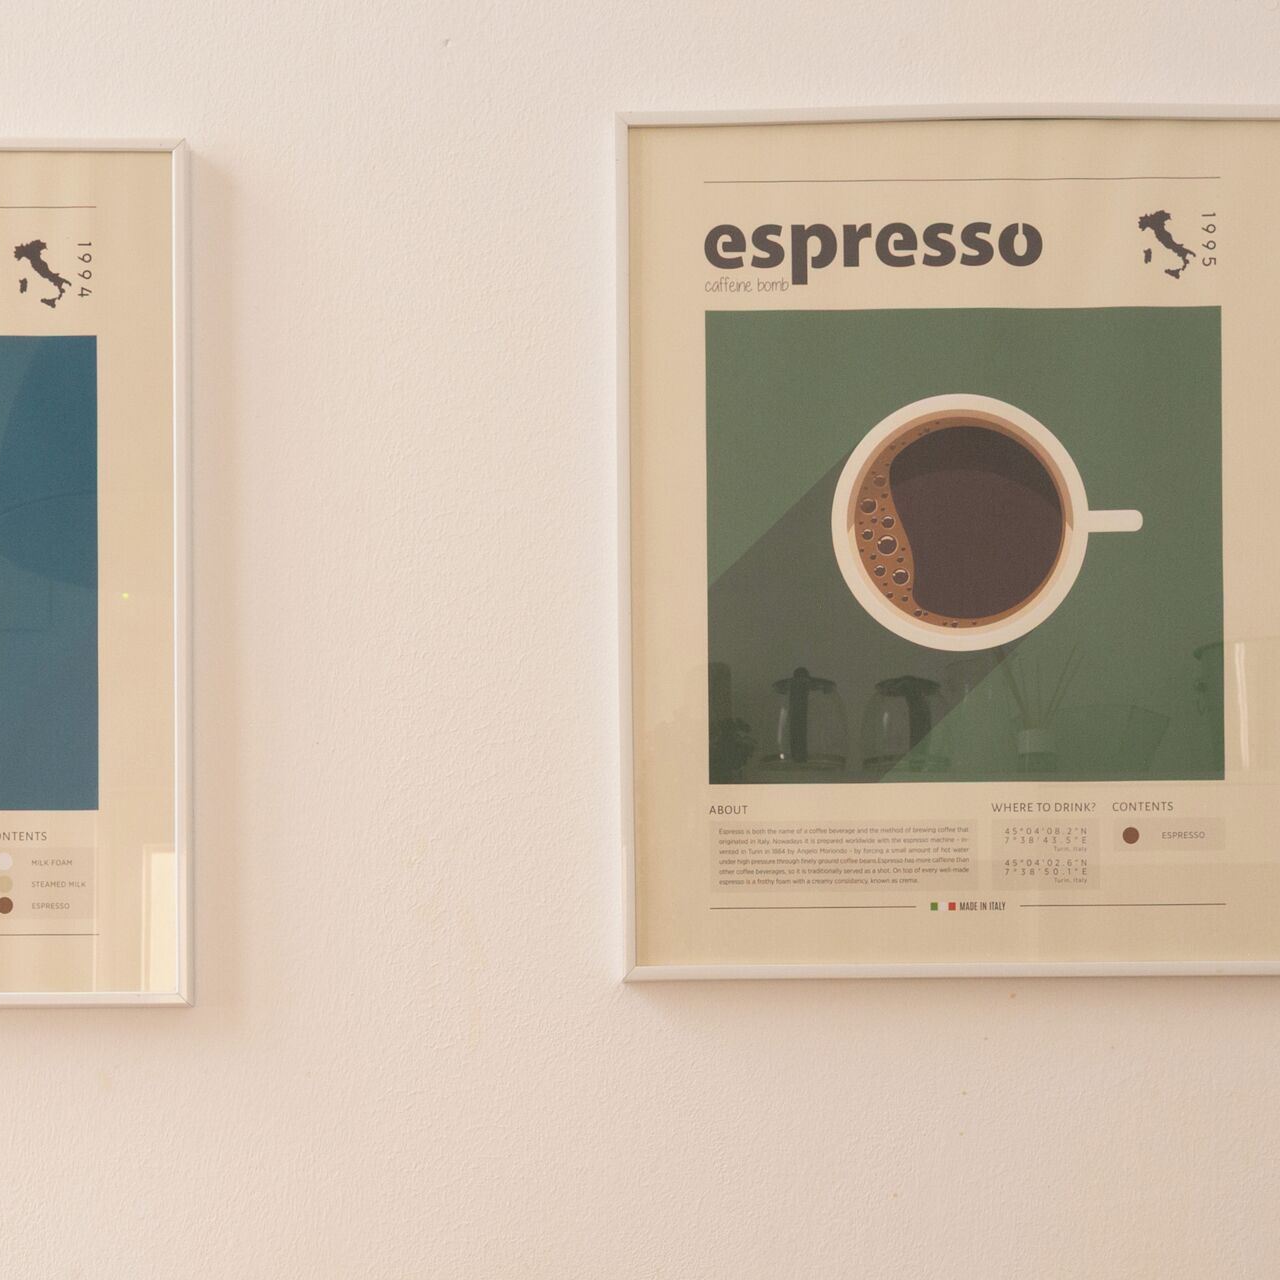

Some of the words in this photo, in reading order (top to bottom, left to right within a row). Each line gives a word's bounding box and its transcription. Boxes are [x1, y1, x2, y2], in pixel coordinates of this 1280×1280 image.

[1201, 212, 1217, 267] 1995
[704, 222, 1043, 286] espresso
[77, 242, 92, 297] 1994
[704, 277, 753, 293] caffeine
[757, 276, 789, 292] bomb
[709, 805, 748, 815] ABOUT
[991, 803, 1033, 812] WHERE
[1037, 803, 1051, 812] TO
[1054, 802, 1096, 812] DRINK?
[1112, 802, 1174, 811] CONTENTS
[1161, 831, 1206, 839] ESPRESSO
[31, 902, 70, 910] ESPRESSO
[959, 902, 978, 911] MADE
[980, 902, 988, 911] IN
[989, 901, 1006, 911] ITALY
